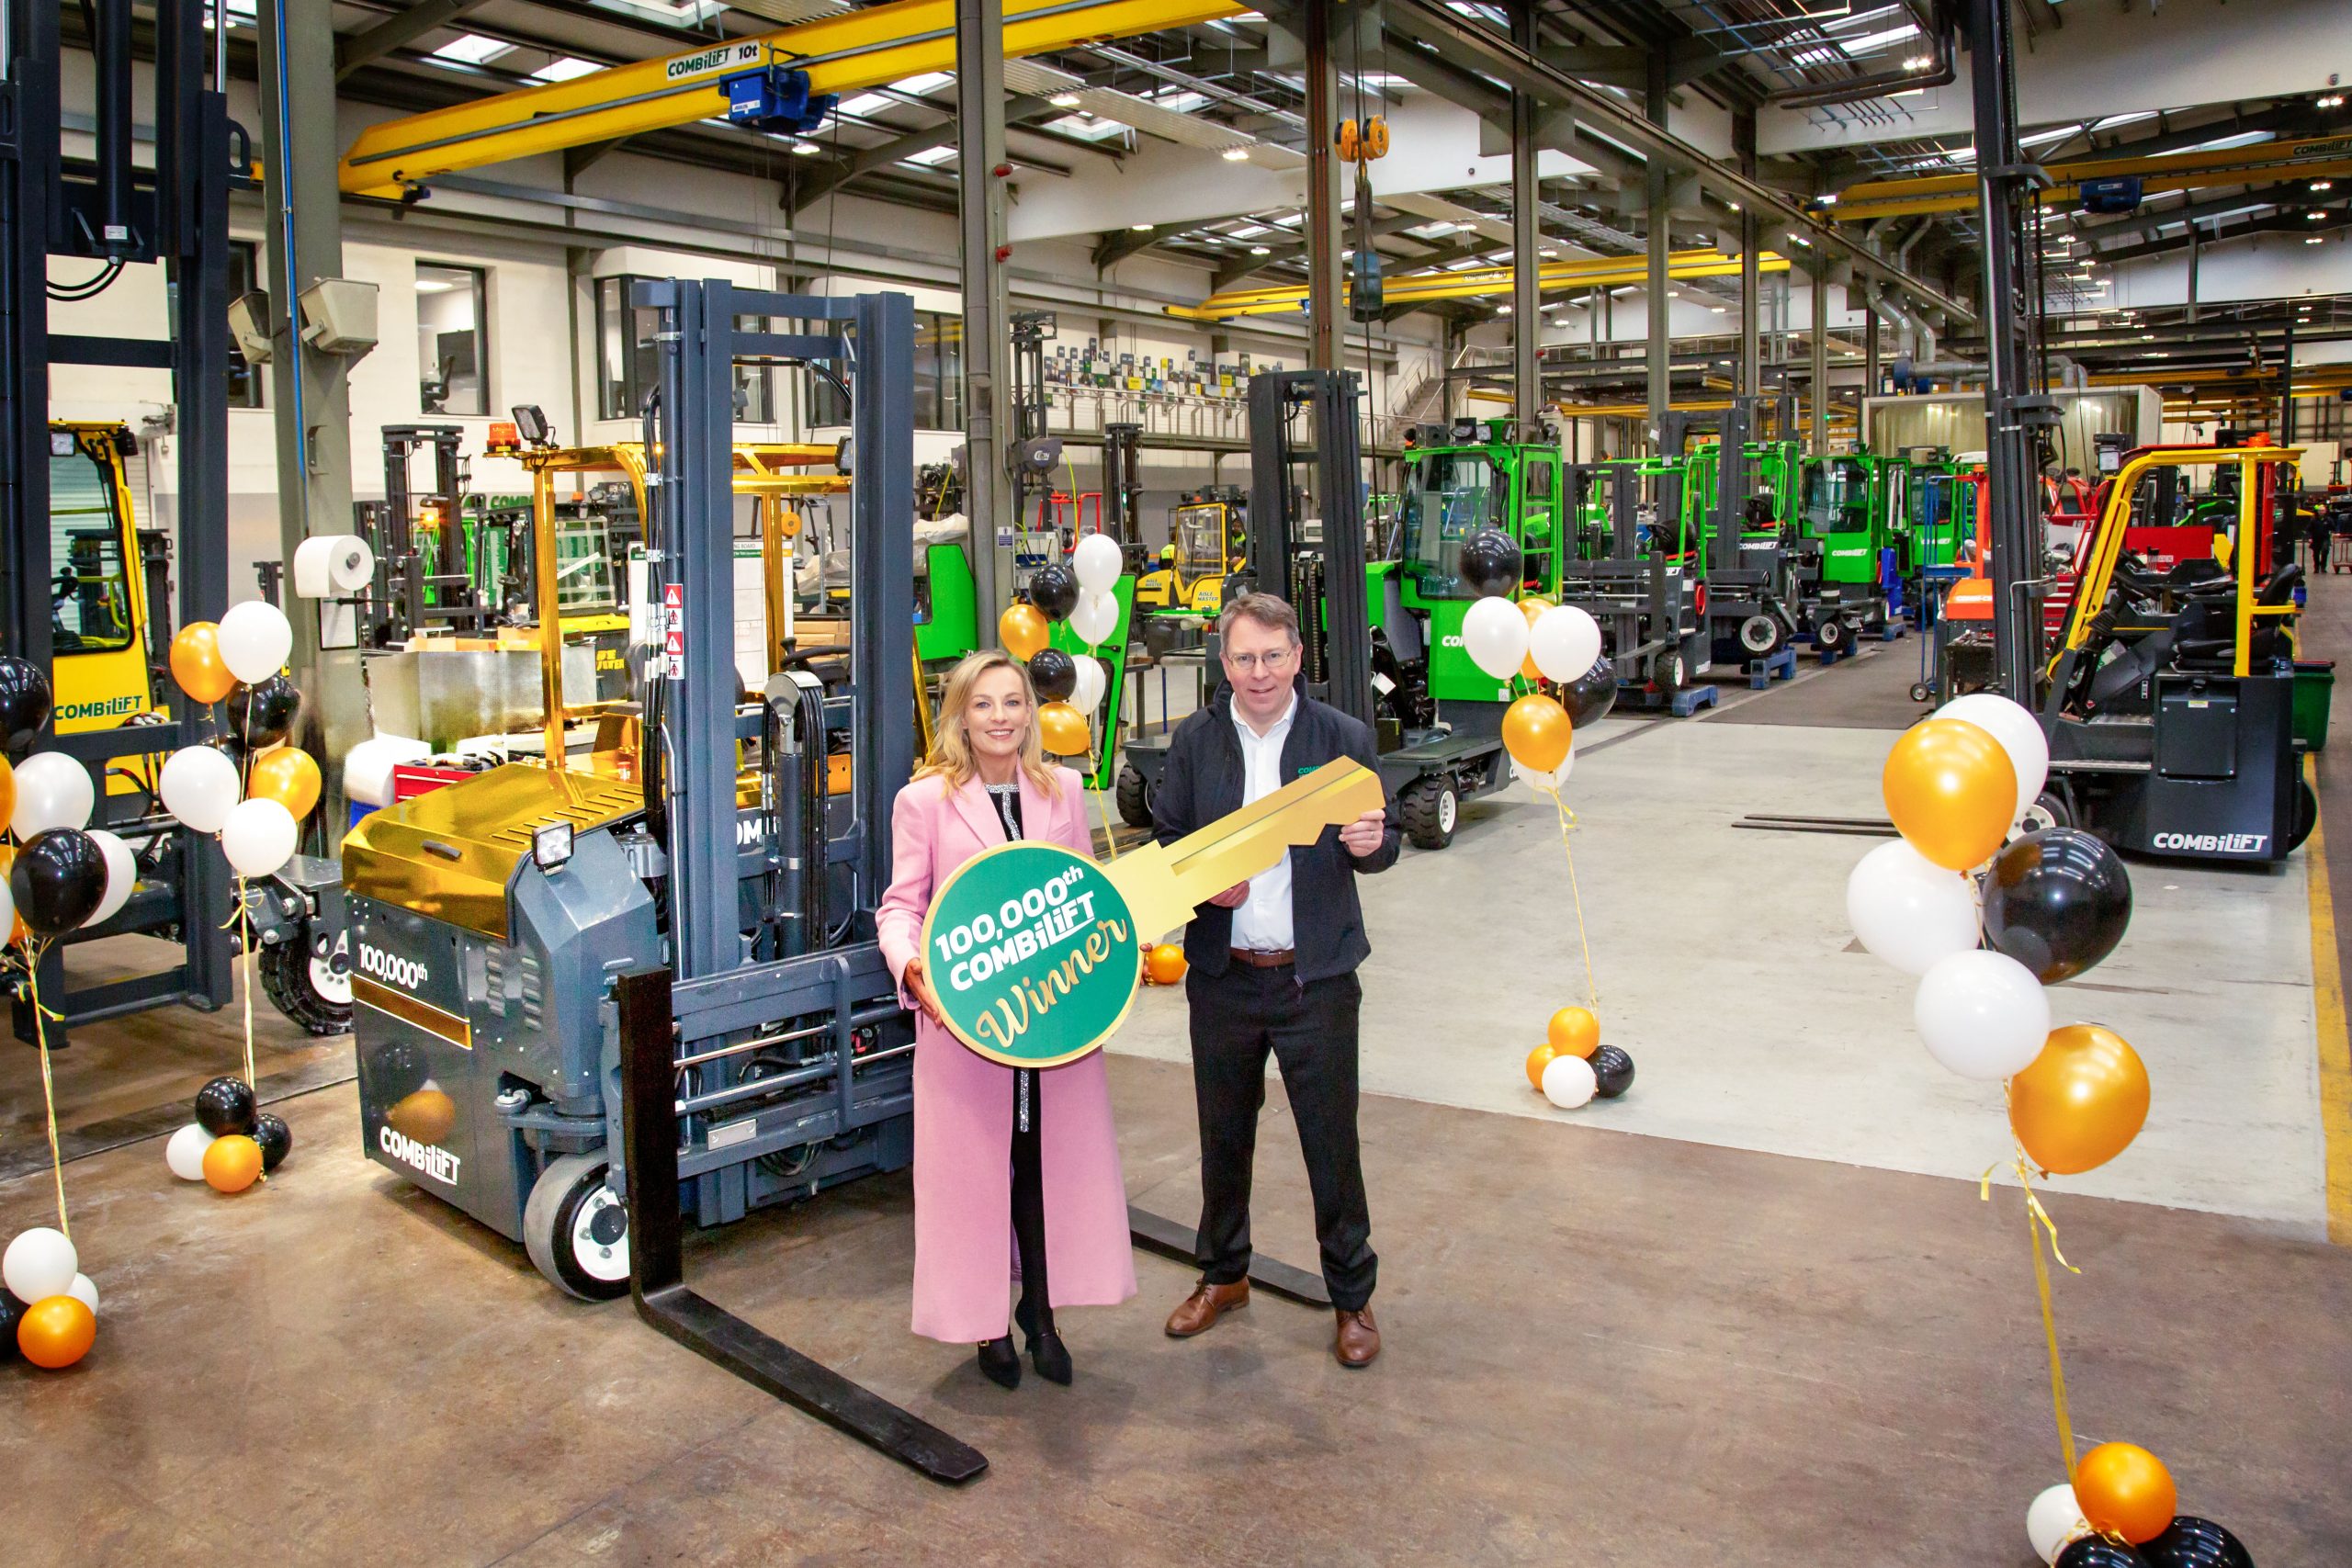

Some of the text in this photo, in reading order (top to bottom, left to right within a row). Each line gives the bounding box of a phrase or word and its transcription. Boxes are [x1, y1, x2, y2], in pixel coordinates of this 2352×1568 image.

[739, 45, 758, 60] 10t
[935, 865, 1084, 962] 100,000th
[359, 942, 428, 989] 100,000th
[976, 919, 1128, 1048] Winner
